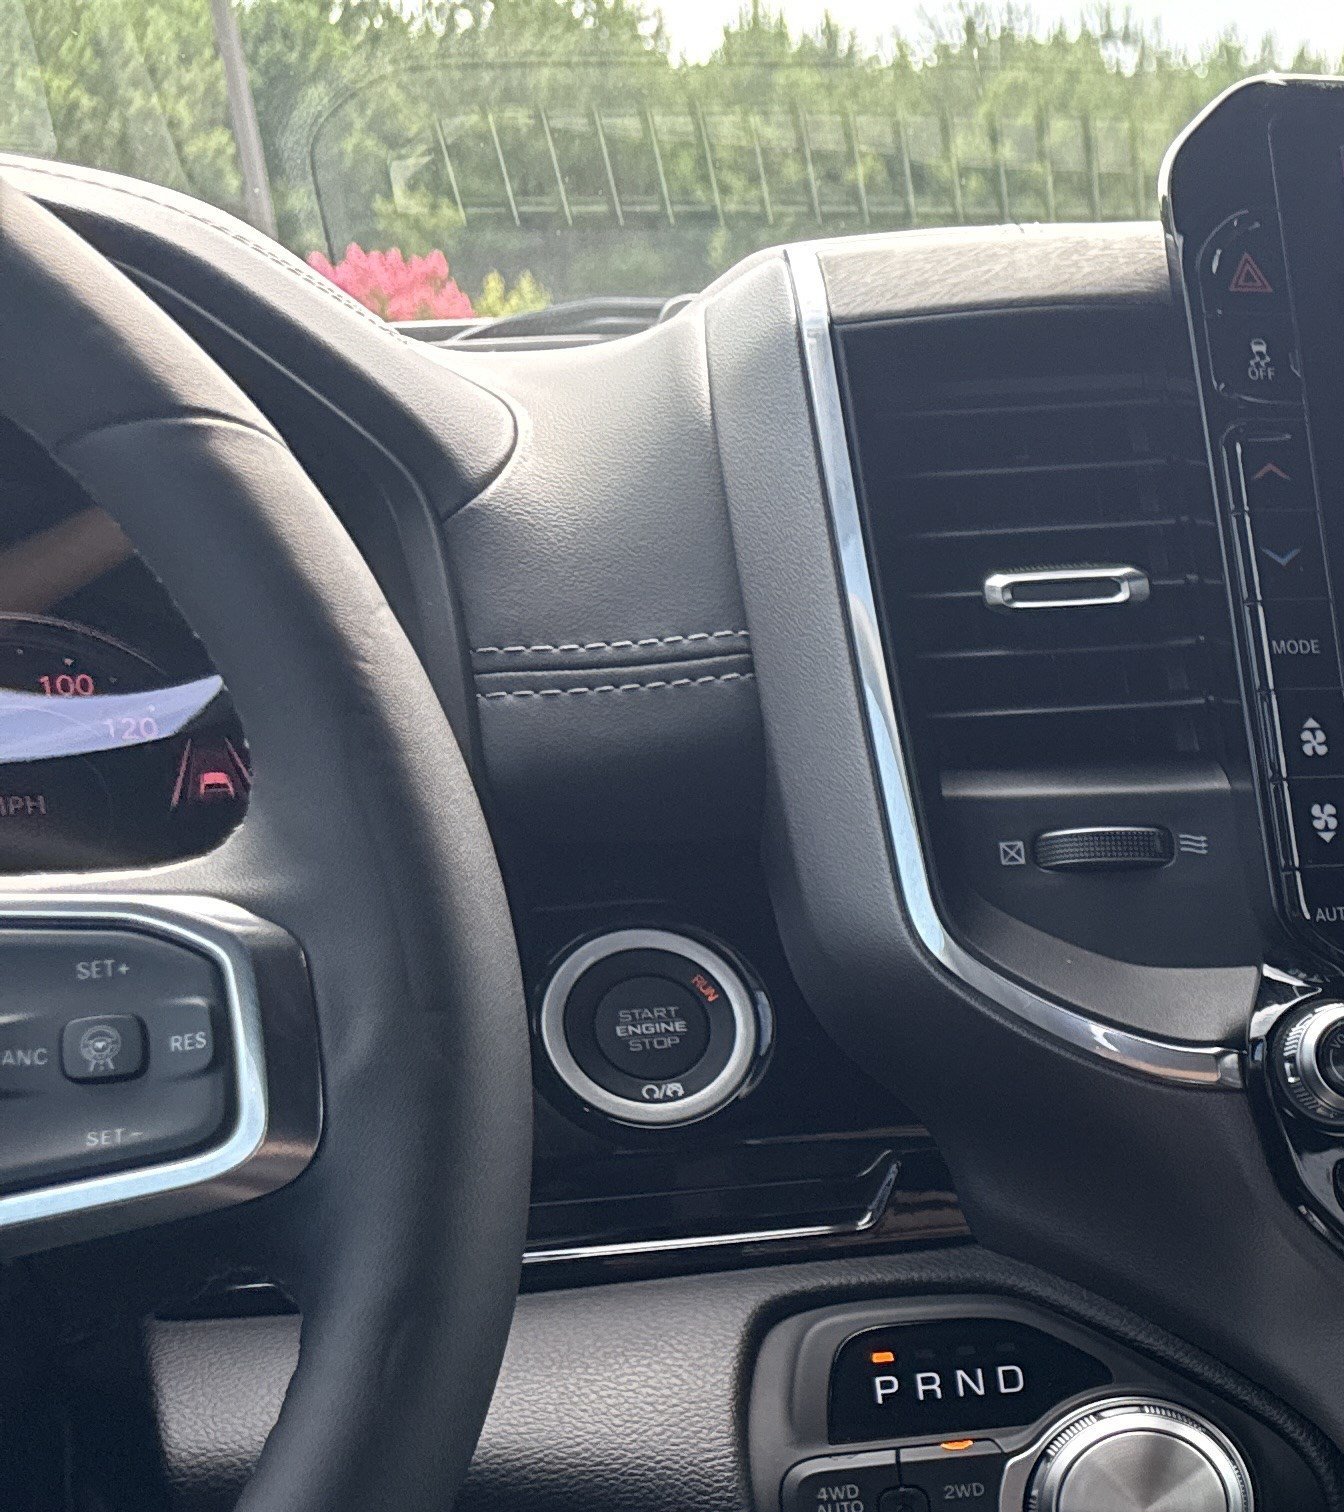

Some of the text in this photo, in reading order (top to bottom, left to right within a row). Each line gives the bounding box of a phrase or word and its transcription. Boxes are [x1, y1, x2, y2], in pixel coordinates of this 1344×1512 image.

[1248, 366, 1275, 380] OFF
[1272, 639, 1321, 655] MODE
[39, 673, 95, 696] 100
[103, 717, 159, 739] 120
[691, 973, 719, 1002] RUN
[618, 1006, 680, 1021] START
[616, 1021, 688, 1037] ENGINE
[171, 1032, 207, 1052] RES
[629, 1037, 680, 1051] STOP
[817, 1485, 860, 1501] 4WD
[944, 1482, 985, 1500] 2WD
